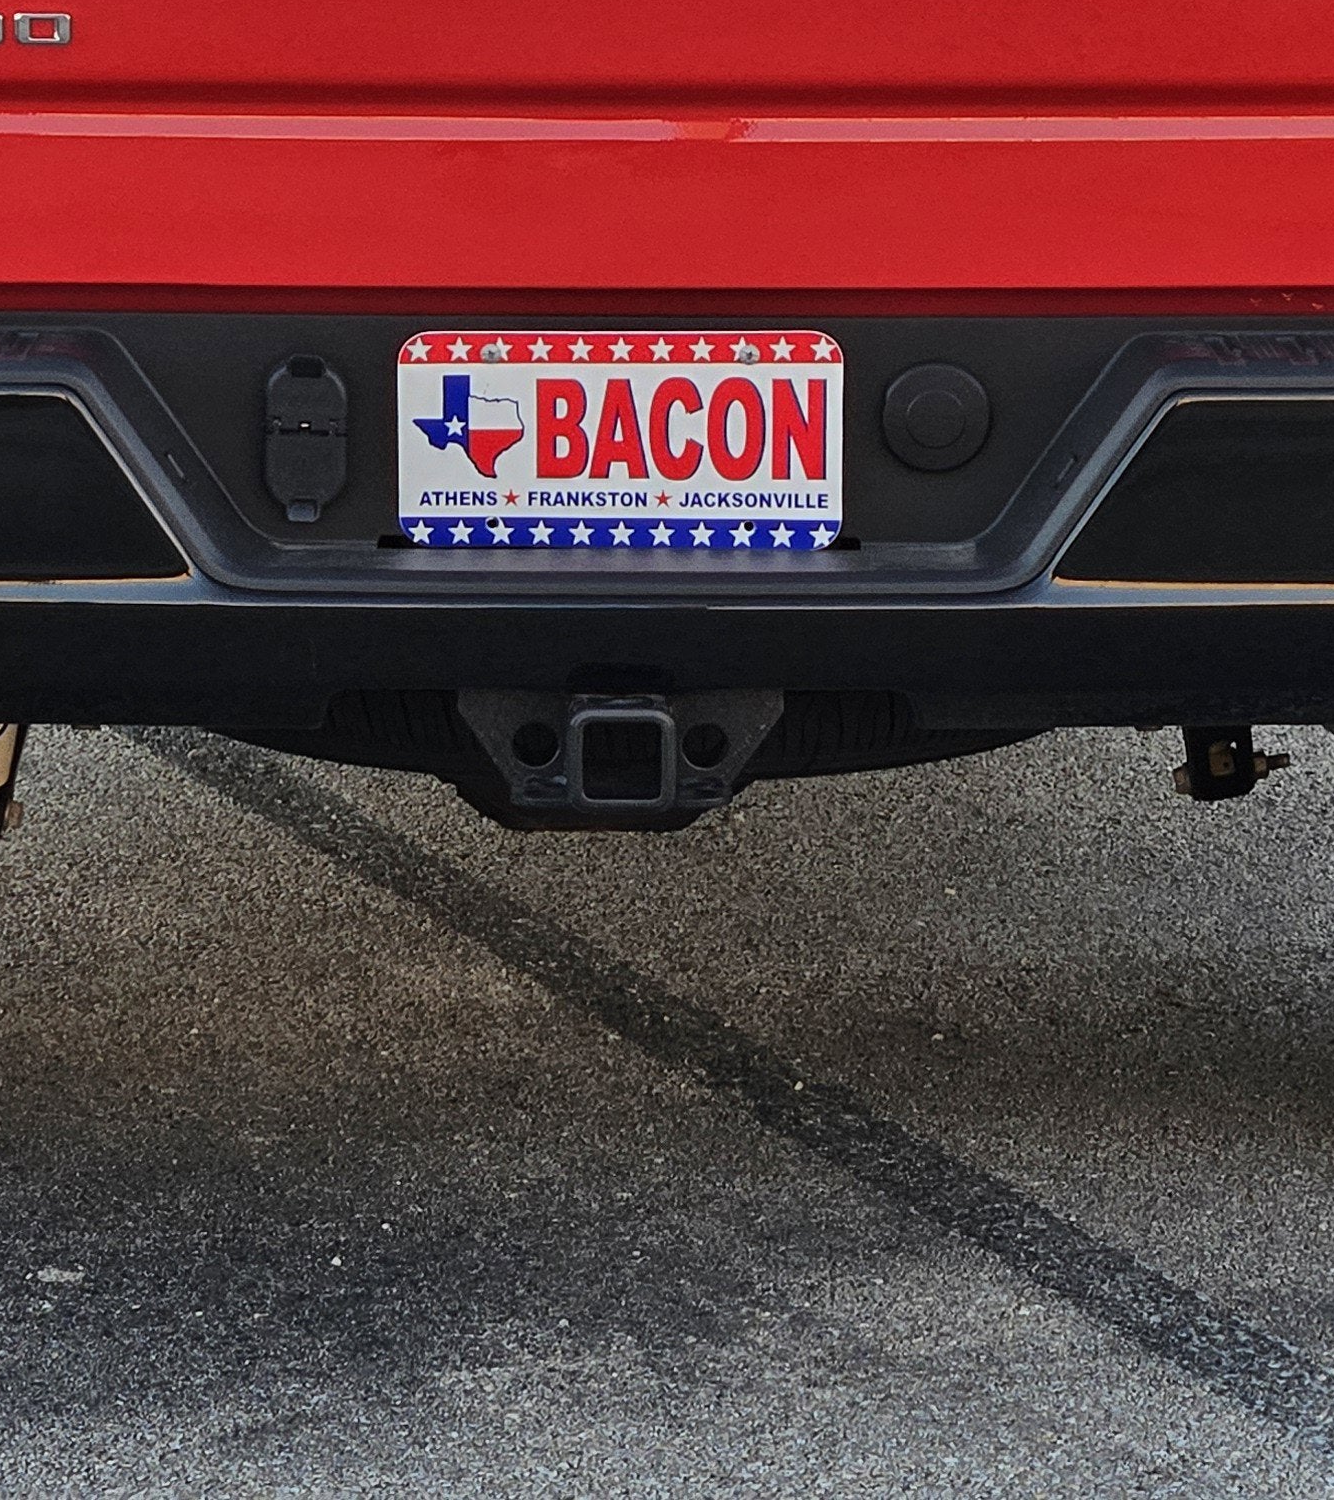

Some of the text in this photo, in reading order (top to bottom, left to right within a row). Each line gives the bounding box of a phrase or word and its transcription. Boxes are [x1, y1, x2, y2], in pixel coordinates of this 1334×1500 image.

[535, 376, 828, 481] BACON
[419, 490, 829, 509] ATHENS FRANKSTON JACKSONVILLE
